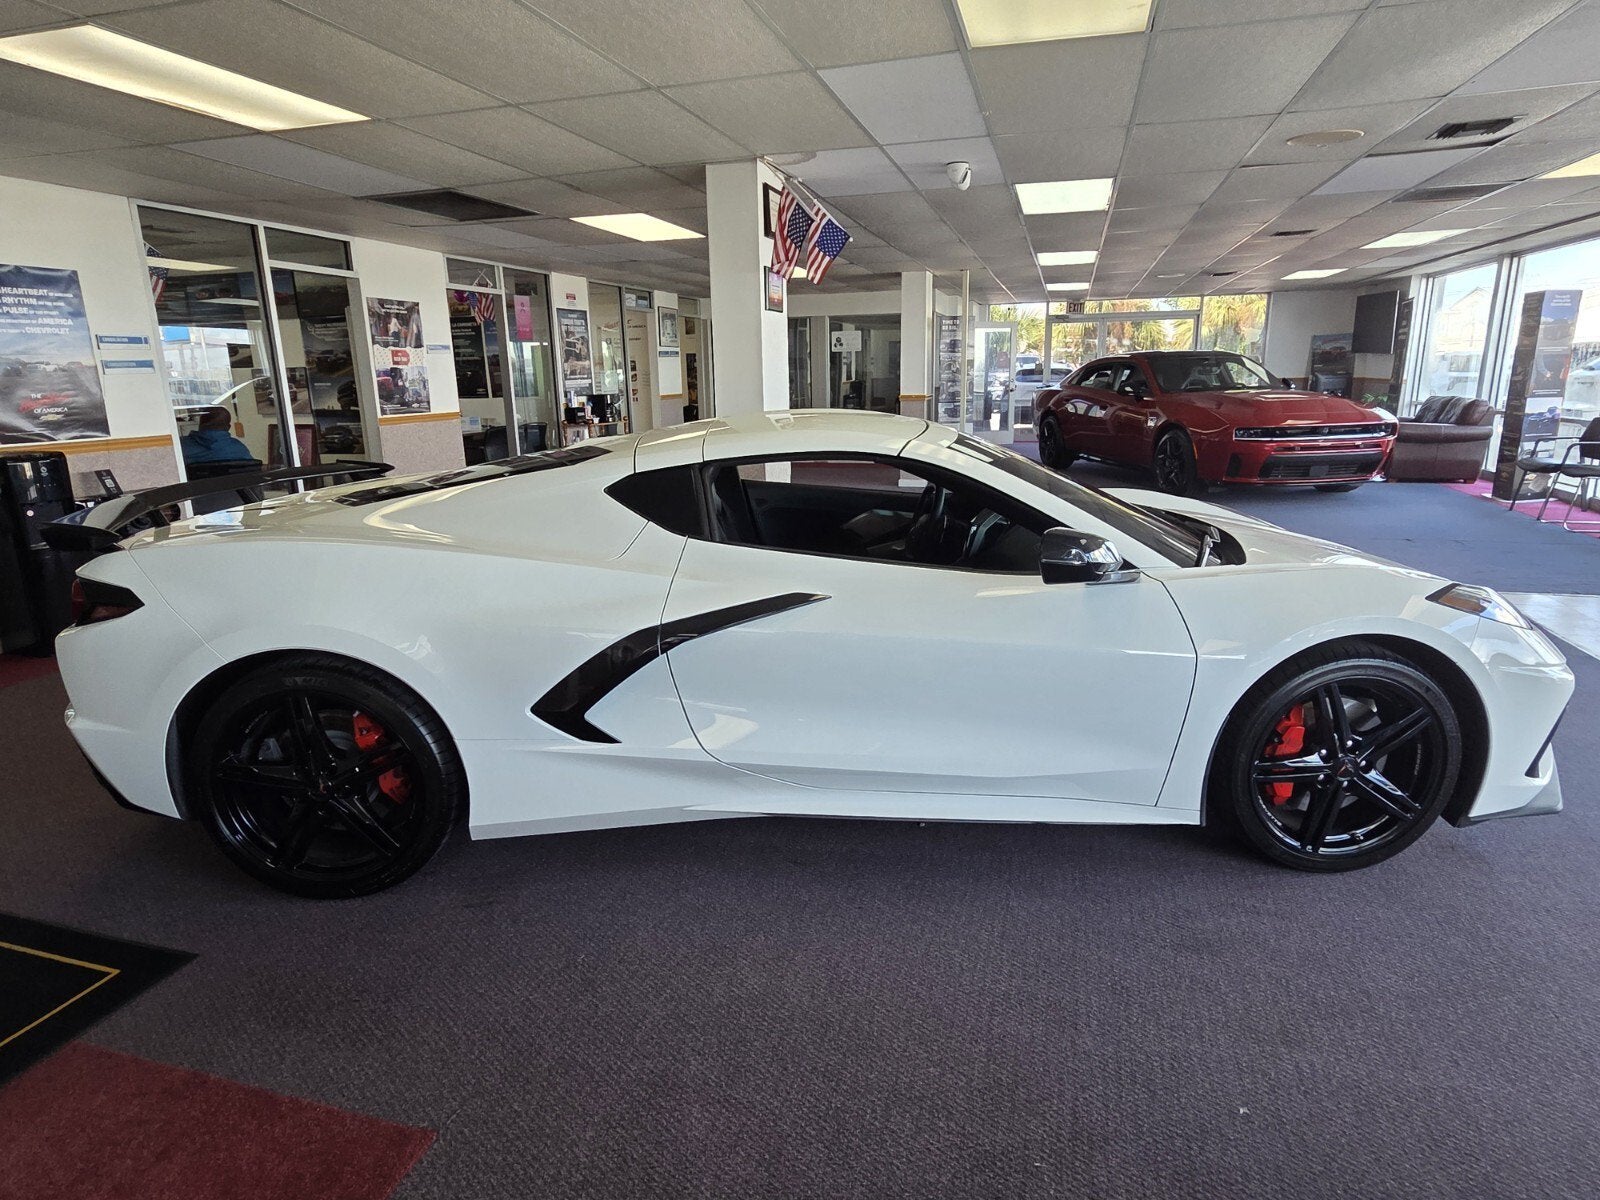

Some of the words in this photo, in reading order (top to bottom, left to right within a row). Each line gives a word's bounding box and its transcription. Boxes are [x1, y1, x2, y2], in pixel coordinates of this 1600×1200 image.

[1, 286, 48, 296] HEARTBEAT
[2, 296, 38, 306] RHYTHM
[2, 306, 29, 315] PULSE
[1069, 302, 1083, 313] EXIT
[37, 317, 74, 325] AMERICA
[25, 326, 70, 335] CHEVROLET
